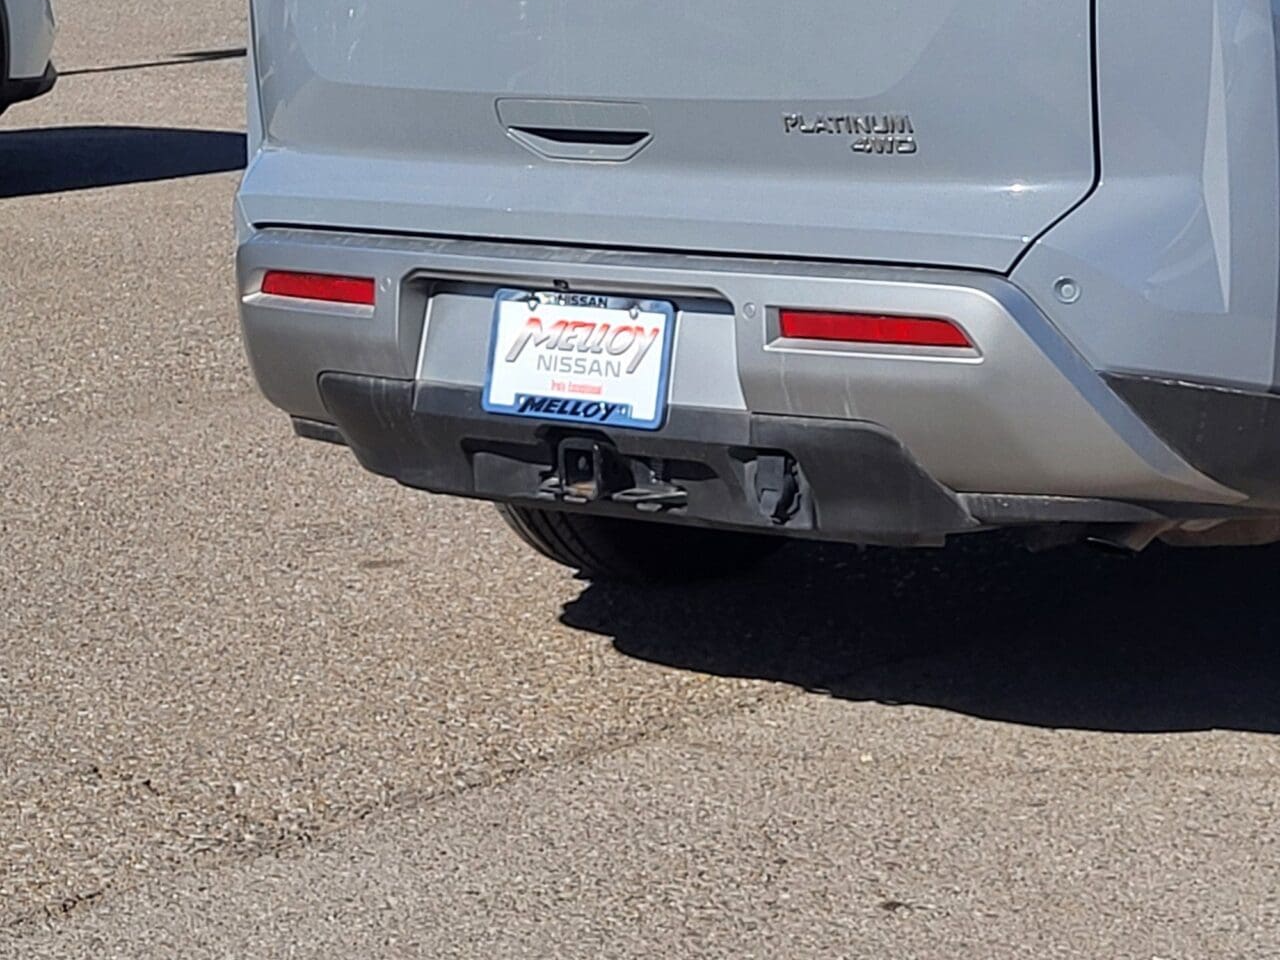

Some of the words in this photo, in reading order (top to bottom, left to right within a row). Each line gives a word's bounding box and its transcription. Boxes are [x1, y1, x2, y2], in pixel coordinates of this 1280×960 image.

[783, 114, 914, 134] PLATINUM
[851, 138, 917, 154] 4WD
[557, 294, 608, 308] NISSAN
[505, 317, 660, 375] MELLOY
[537, 354, 622, 377] NISSAN
[518, 396, 616, 421] MELLOY
